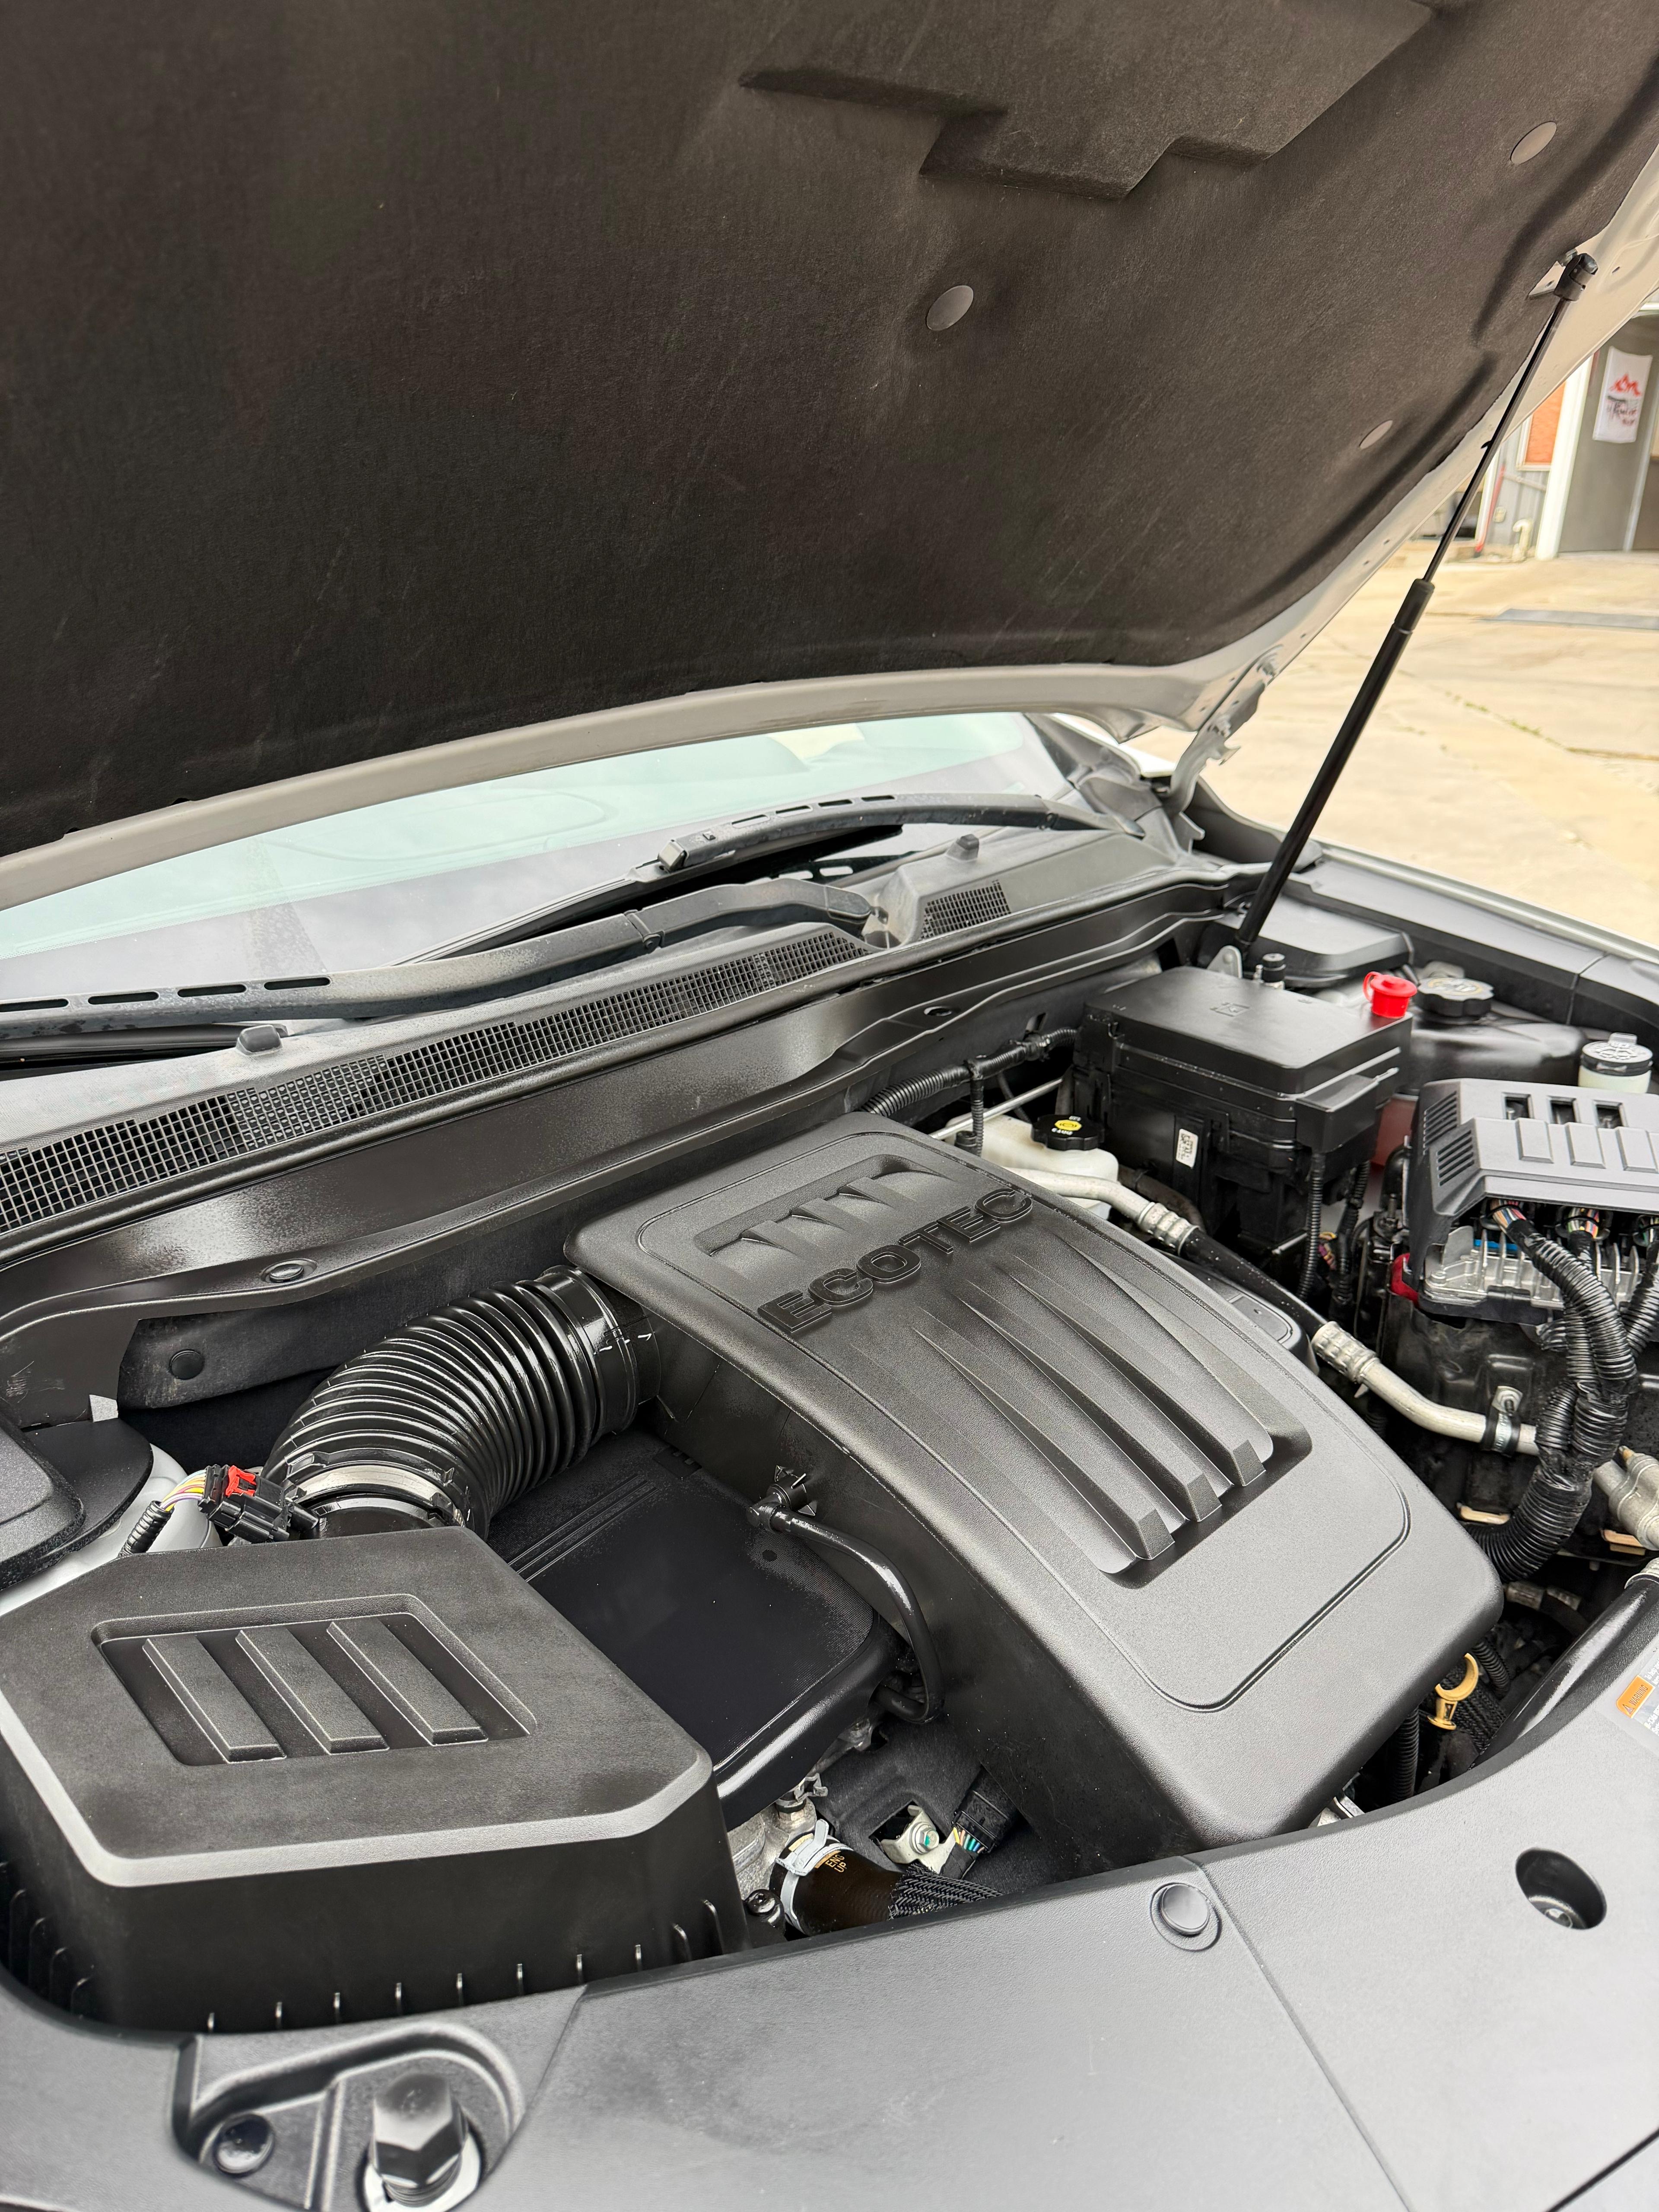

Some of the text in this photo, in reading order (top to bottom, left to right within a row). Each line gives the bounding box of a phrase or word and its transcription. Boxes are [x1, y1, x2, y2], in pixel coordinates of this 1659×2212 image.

[757, 1187, 1033, 1333] ECOTEC
[1629, 1684, 1648, 1706] WARNING
[825, 1854, 845, 1868] ENG
[834, 1862, 847, 1872] UP
